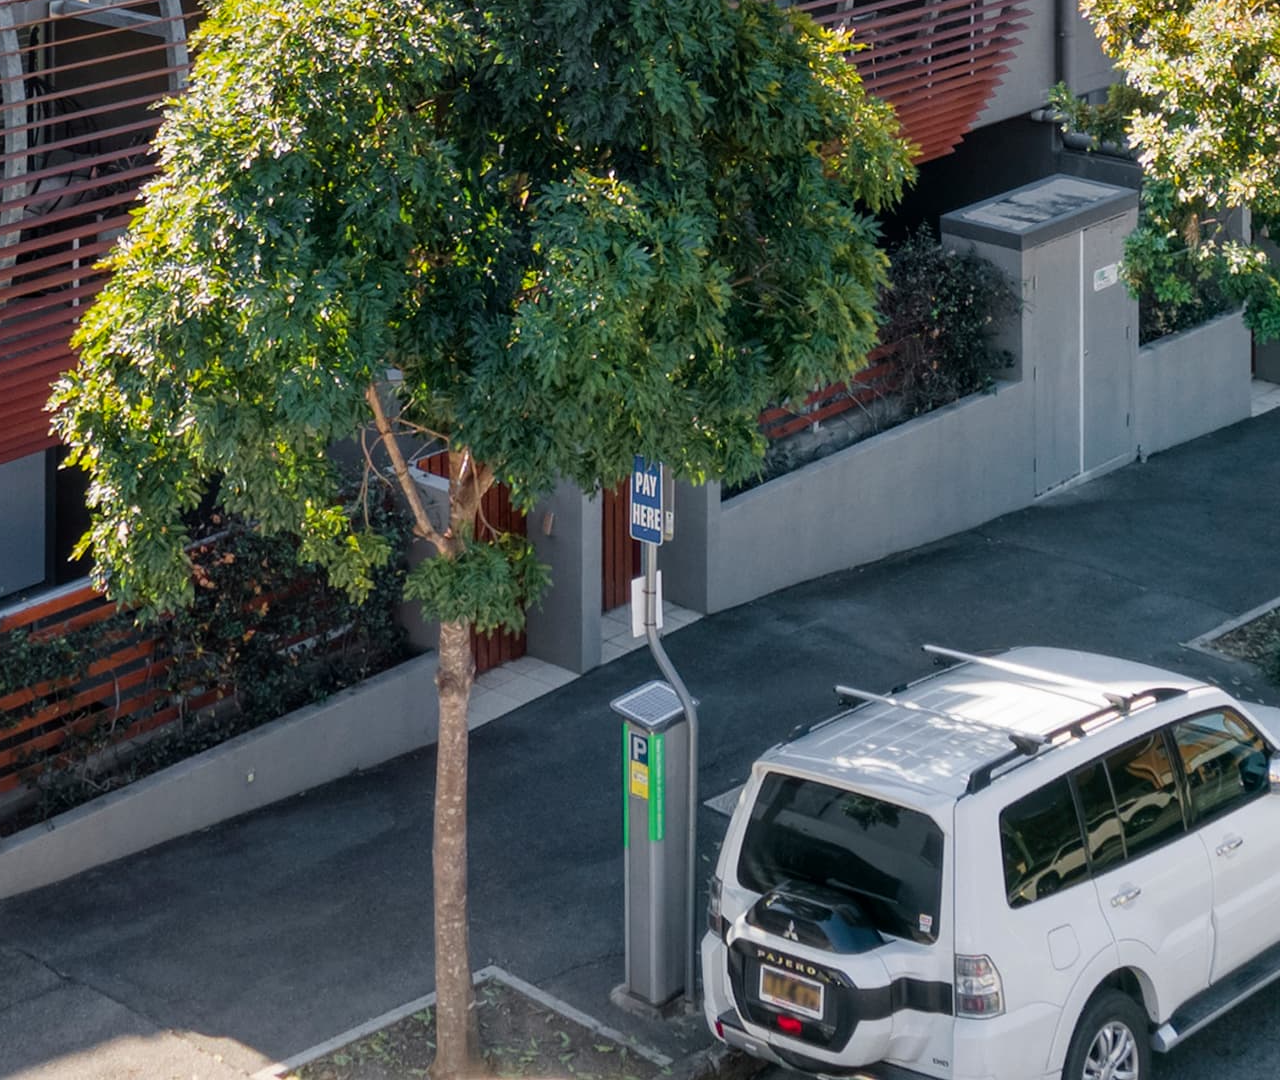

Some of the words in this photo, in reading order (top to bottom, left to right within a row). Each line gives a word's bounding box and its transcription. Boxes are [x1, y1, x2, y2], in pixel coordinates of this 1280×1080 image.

[636, 471, 656, 497] PAY
[633, 502, 661, 531] HERE
[633, 736, 647, 760] P
[757, 949, 817, 976] PAJERO
